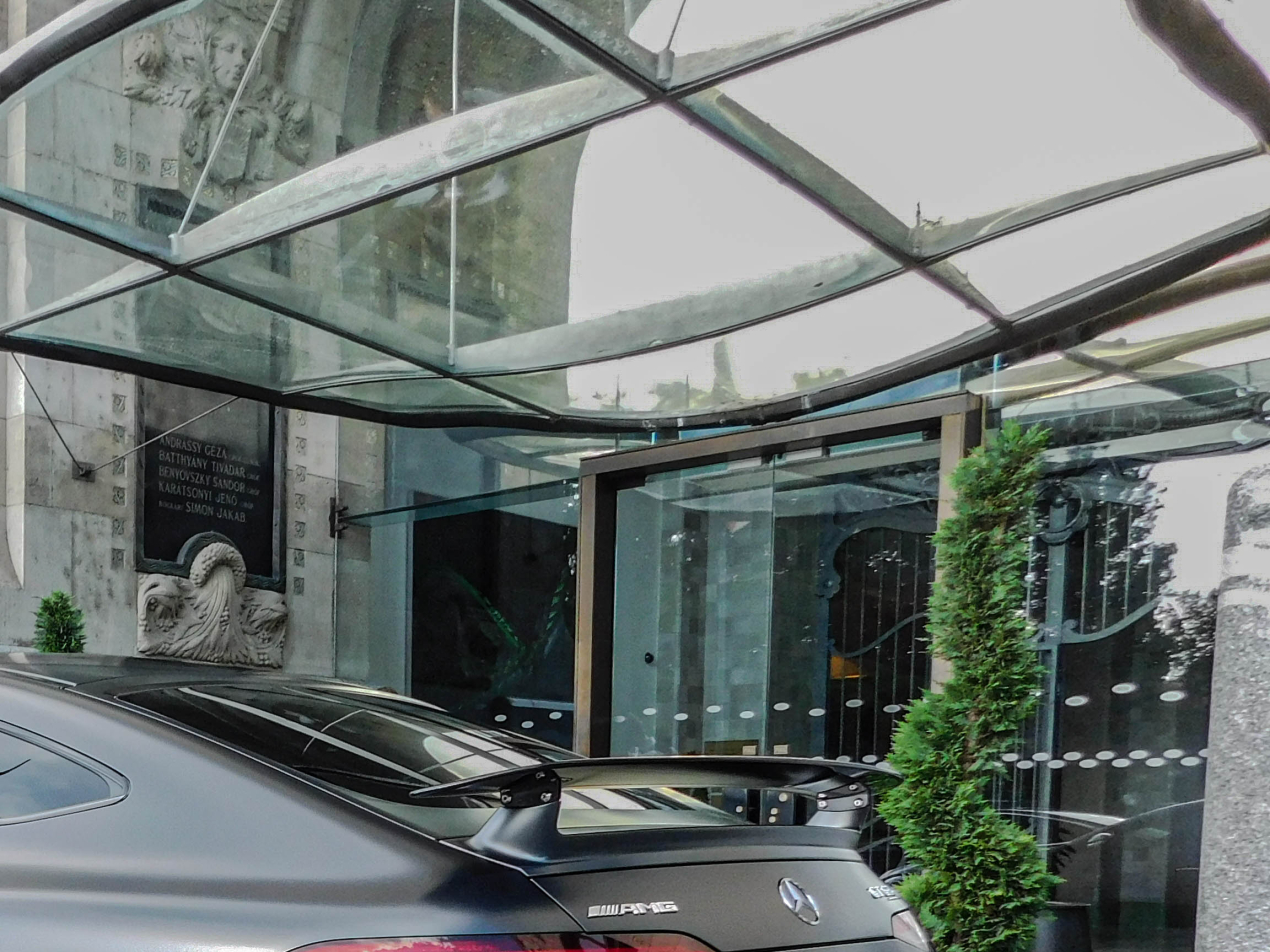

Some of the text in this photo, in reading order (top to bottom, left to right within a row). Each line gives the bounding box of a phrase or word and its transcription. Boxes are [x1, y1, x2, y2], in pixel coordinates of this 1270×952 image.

[211, 461, 246, 478] TIVADAR
[185, 501, 214, 517] SIMON
[216, 508, 246, 523] JAKAB
[617, 901, 679, 916] AMG
